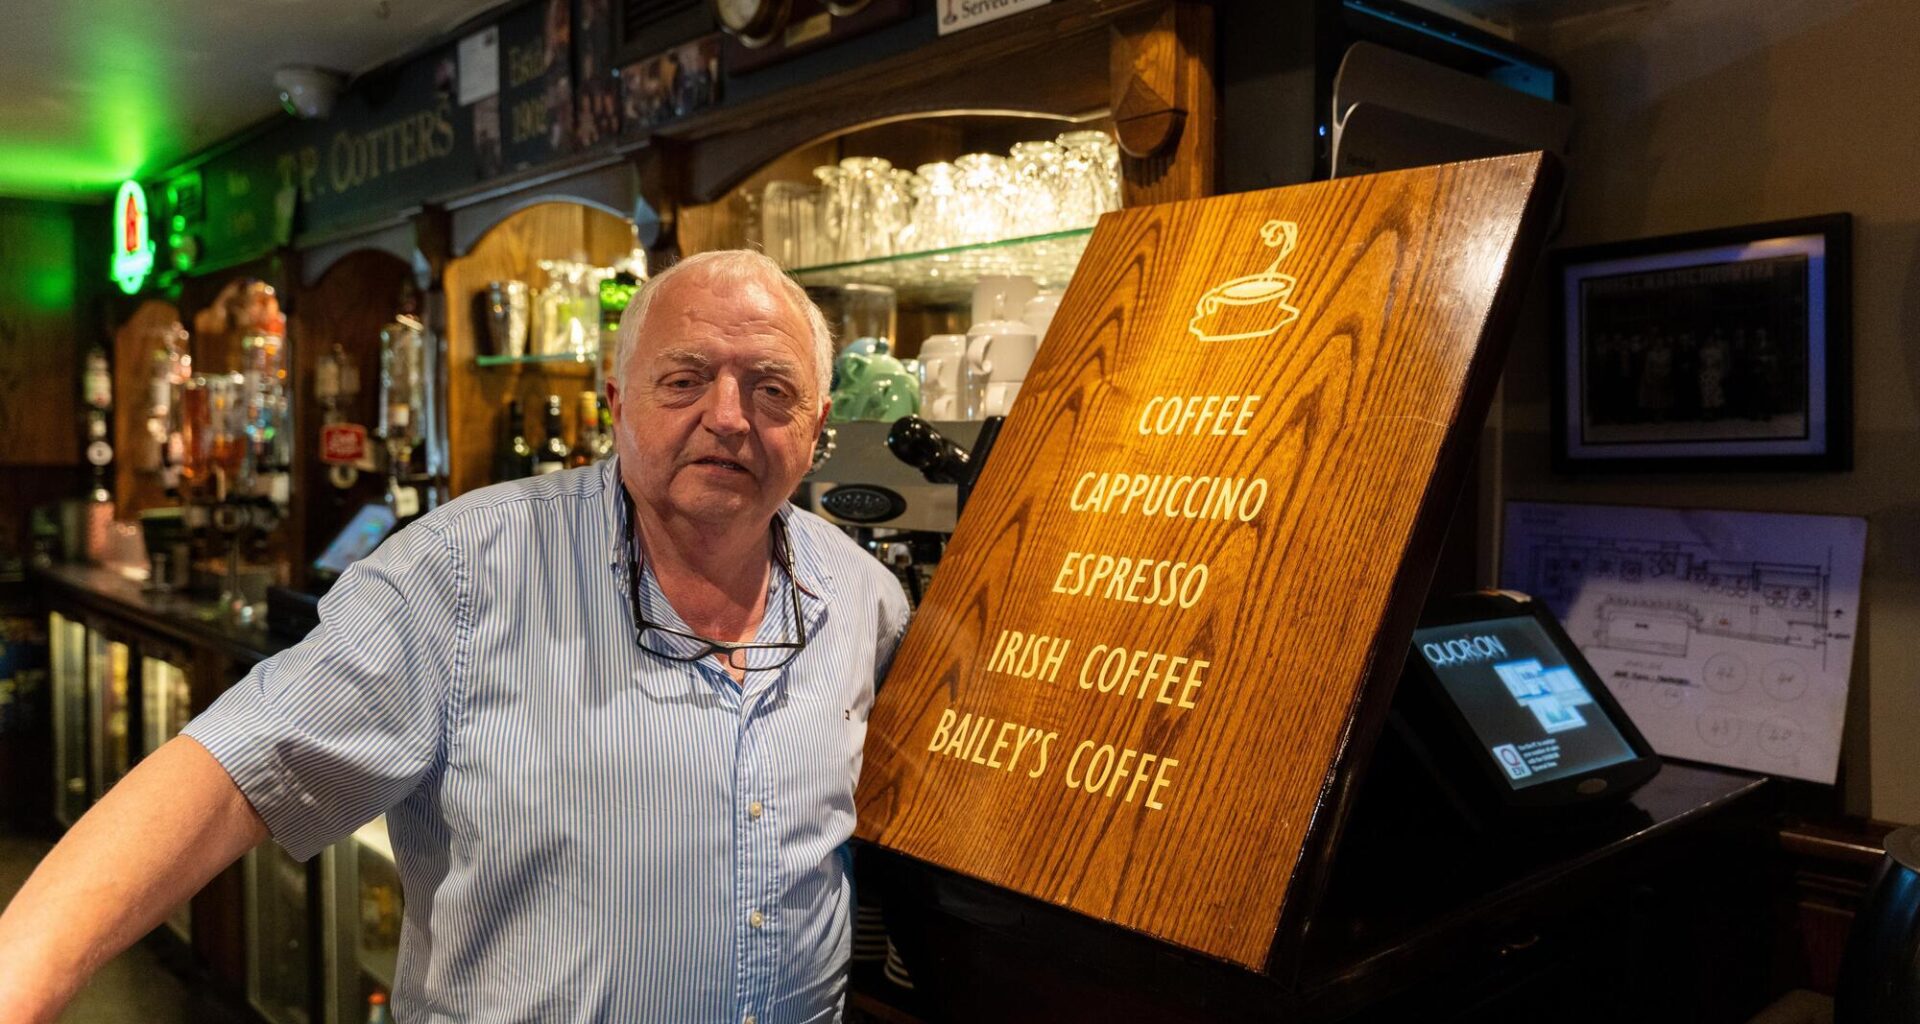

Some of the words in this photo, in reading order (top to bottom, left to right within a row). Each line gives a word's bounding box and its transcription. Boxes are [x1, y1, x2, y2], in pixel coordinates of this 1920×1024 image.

[1138, 394, 1261, 437] COFFEE
[1069, 471, 1268, 522] CAPPUCCINO
[1052, 552, 1209, 609] ESPRESSO
[987, 629, 1072, 683] IRISH
[1079, 643, 1211, 709] COFFEE
[928, 708, 1058, 778] BAILEY'S
[1065, 739, 1179, 811] COFFE
